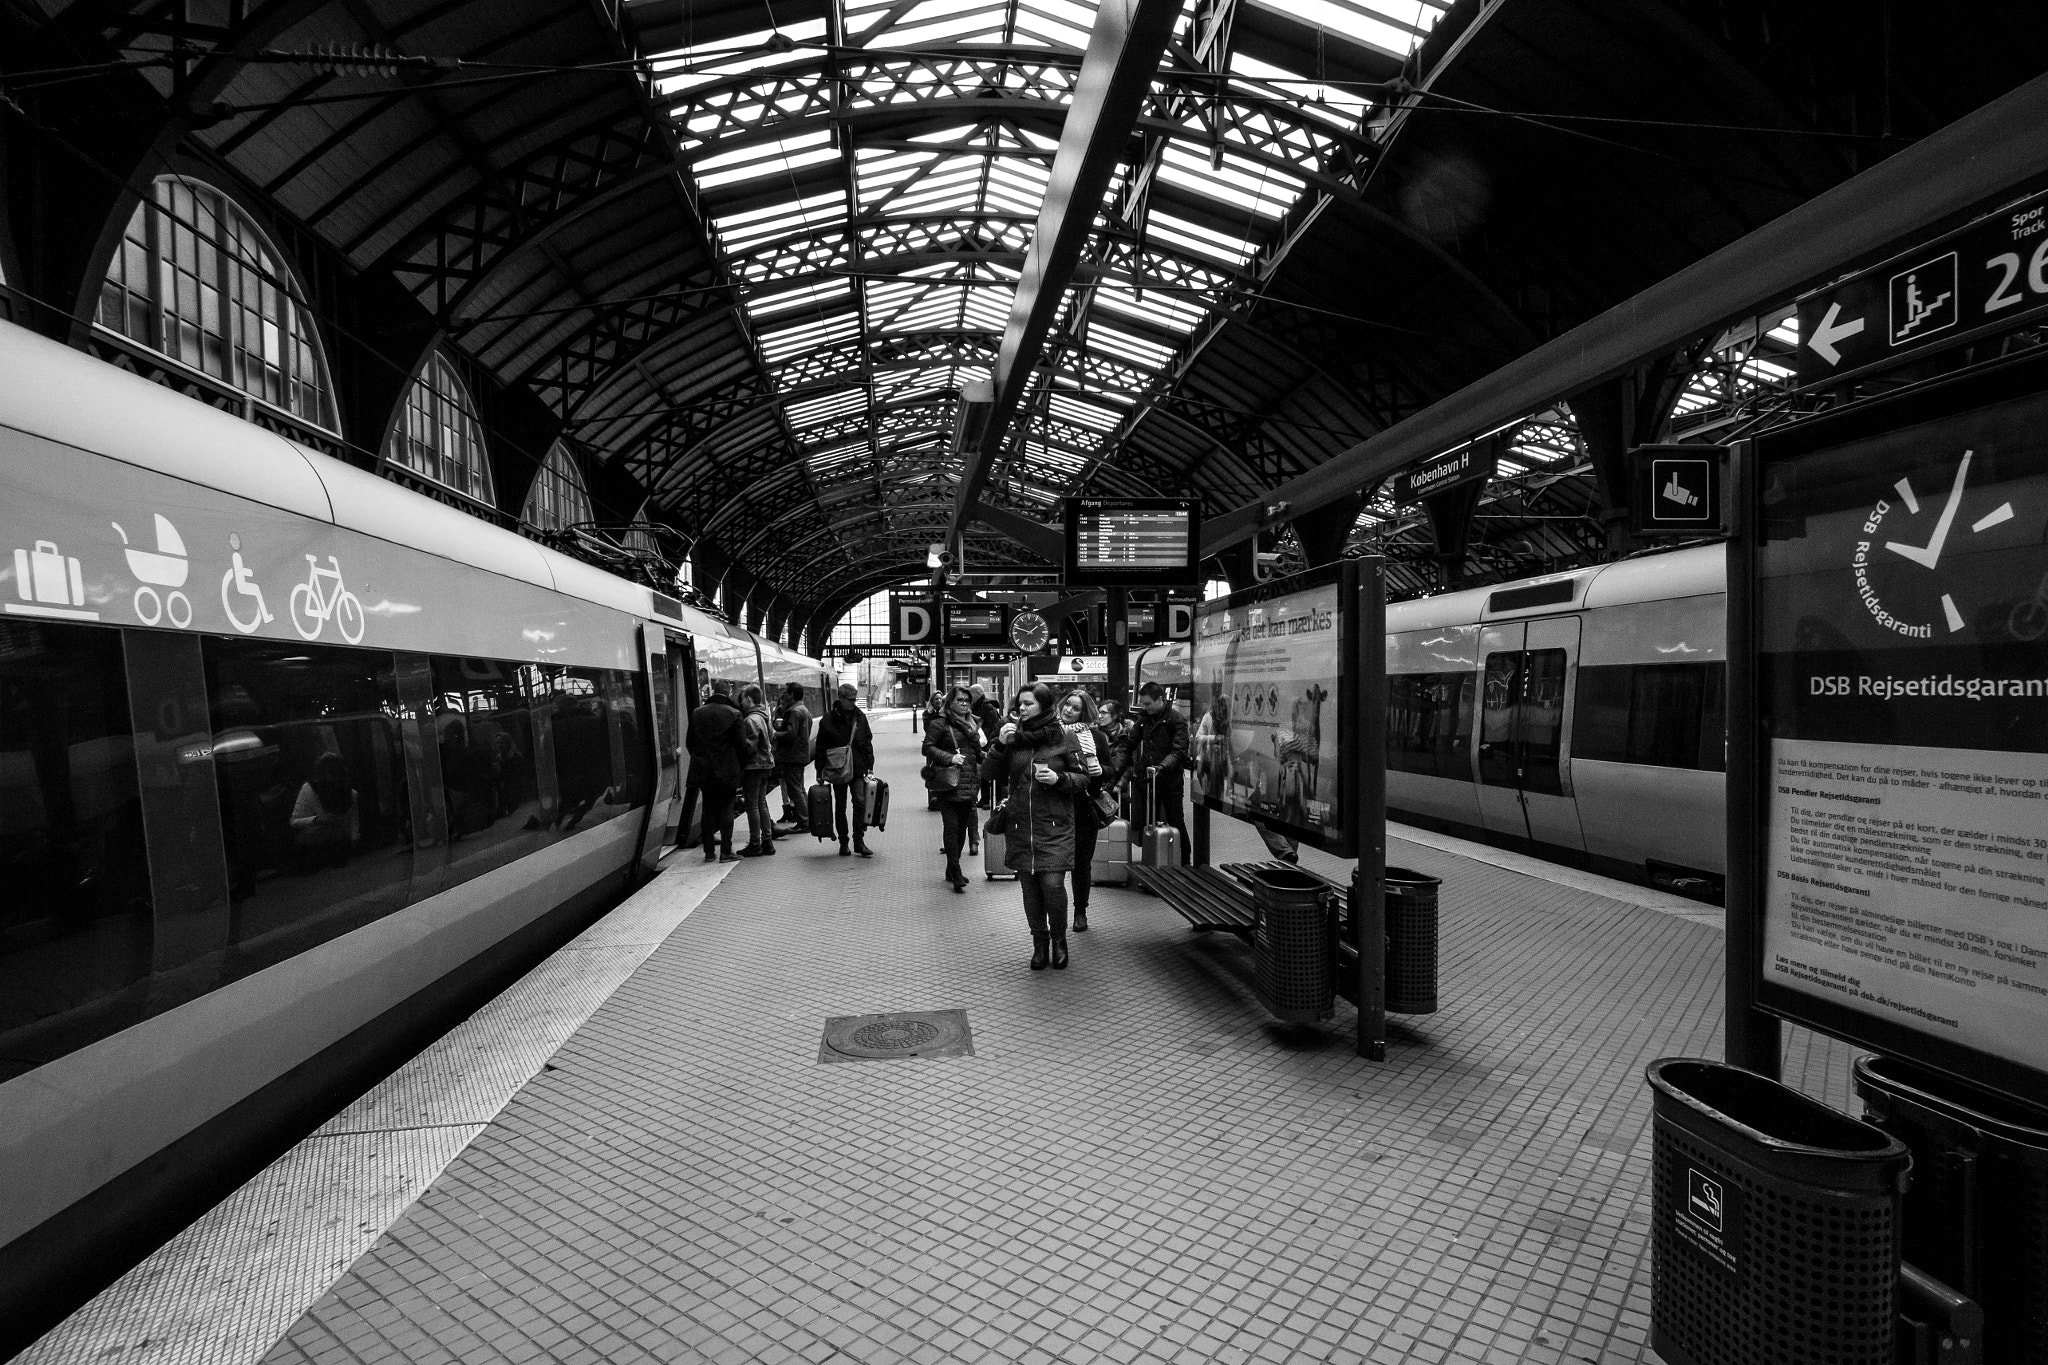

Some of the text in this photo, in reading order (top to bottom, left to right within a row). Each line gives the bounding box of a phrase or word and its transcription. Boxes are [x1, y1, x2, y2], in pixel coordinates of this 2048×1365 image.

[2012, 206, 2044, 226] Spor
[2012, 219, 2045, 240] Track
[1410, 452, 1468, 488] København H
[1852, 500, 1931, 638] DSB Rejsetidsgaranti
[901, 606, 931, 640] D
[1168, 604, 1191, 638] D
[1268, 616, 1286, 638] kan
[1288, 608, 1332, 636] mærkes
[1810, 676, 1850, 696] DSB
[1808, 760, 1859, 772] kompensation
[1861, 764, 1872, 772] for
[1874, 766, 1890, 774] dine
[1920, 769, 1938, 778] hvis
[1940, 772, 1970, 780] togene
[1974, 773, 1992, 782] ikke
[1994, 774, 2020, 785] lever
[2022, 778, 2036, 788] op
[1836, 772, 1850, 780] Det
[1852, 774, 1864, 782] kan
[1878, 776, 1888, 785] på
[1902, 779, 1930, 788] måder
[1986, 786, 1997, 796] af,
[2000, 787, 2041, 799] hvordan
[1778, 786, 1880, 804] DSB Pendler Rejsetidsgaranti
[1791, 806, 1799, 814] Til
[1828, 813, 1855, 822] pendler
[1857, 817, 1867, 825] og
[1869, 818, 1891, 827] rejser
[1893, 820, 1903, 829] på
[1917, 824, 1938, 834] kort,
[1941, 827, 1956, 836] der
[1958, 830, 1988, 840] gælder
[1997, 836, 2030, 847] mindst
[2034, 838, 2048, 848] 30
[1791, 816, 1800, 824] Du
[1802, 819, 1832, 829] tilmelder
[1834, 823, 1845, 832] dig
[1922, 836, 1941, 844] som
[1954, 840, 1971, 849] den
[1974, 843, 2023, 858] strækning,
[2026, 850, 2044, 860] der
[1791, 826, 1808, 836] bedst
[1860, 838, 1931, 856] pendlerstrækning
[1791, 835, 1800, 844] Du
[1802, 836, 1810, 844] får
[1812, 840, 1851, 852] automatisk
[1914, 856, 1930, 865] når
[1932, 858, 1962, 871] togene
[1964, 864, 1976, 874] på
[1978, 866, 1992, 876] din
[1995, 870, 2045, 886] strækning
[1806, 848, 1941, 878] overholder kunderettidighedsmålet
[1778, 870, 1870, 897] DSB Basis Rejsetidsgaranti
[1791, 854, 2048, 910] Udbetalingen sker ca. midt hver måned for den forrige måned
[1791, 902, 2037, 969] Rejsetidsgarantien når du er mindst 30 forsinket
[1812, 916, 1887, 942] bestemmelsesstation
[1815, 898, 2012, 952] der rejser på almindelige billetter med tog
[1776, 954, 1860, 988] Læs mere og tilmeld dig
[1792, 920, 1801, 930] Du
[1803, 923, 1815, 933] kan
[1854, 938, 1863, 946] du
[1865, 941, 1874, 950] vil
[1876, 943, 1894, 954] have
[1896, 950, 1906, 958] en
[1909, 950, 1931, 964] billet
[1934, 958, 1942, 968] til
[1945, 962, 1956, 970] en
[1958, 966, 1970, 976] ny
[1972, 968, 1994, 981] rejse
[1997, 976, 2008, 985] på
[2010, 980, 2048, 996] samme
[1824, 940, 1976, 988] eller have penge ind på din NemKonto
[1776, 963, 1958, 1028] DSB Rejsetidsgaranti på dsb.dk/rejsetidsgaranti
